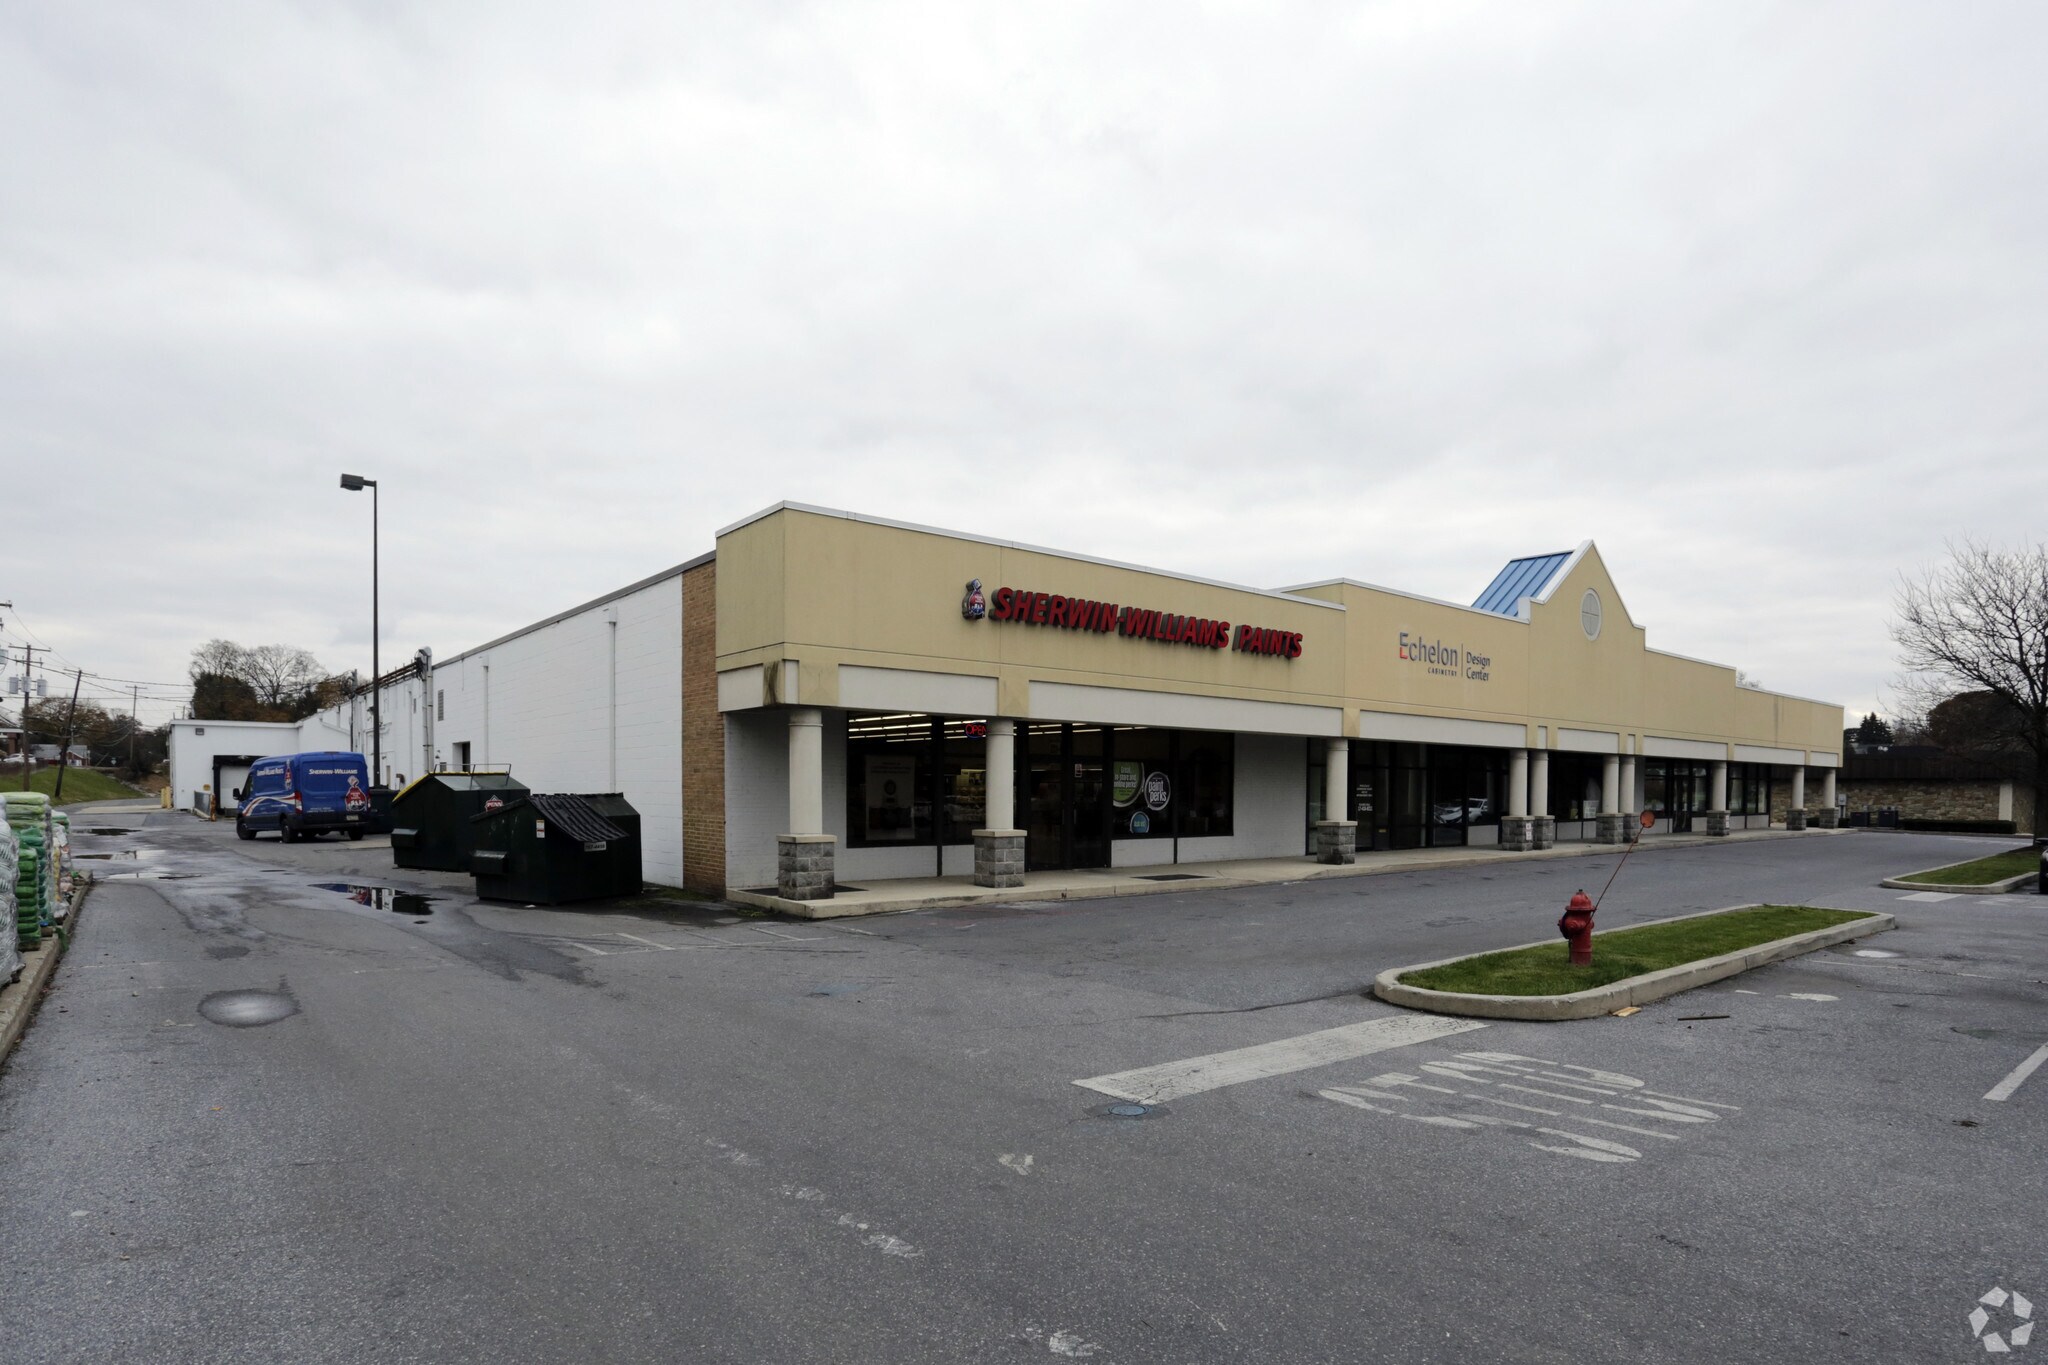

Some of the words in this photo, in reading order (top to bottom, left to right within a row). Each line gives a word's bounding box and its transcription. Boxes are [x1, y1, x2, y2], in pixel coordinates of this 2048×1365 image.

[989, 587, 1231, 649] SHERWIN-WILLIAMS
[1236, 624, 1303, 659] PAINTS
[1399, 632, 1458, 667] Echelon
[1466, 651, 1490, 669] Design
[1466, 667, 1489, 681] Center
[1148, 779, 1164, 792] paint
[1150, 790, 1167, 803] perks
[1318, 1052, 1741, 1163] STOP
